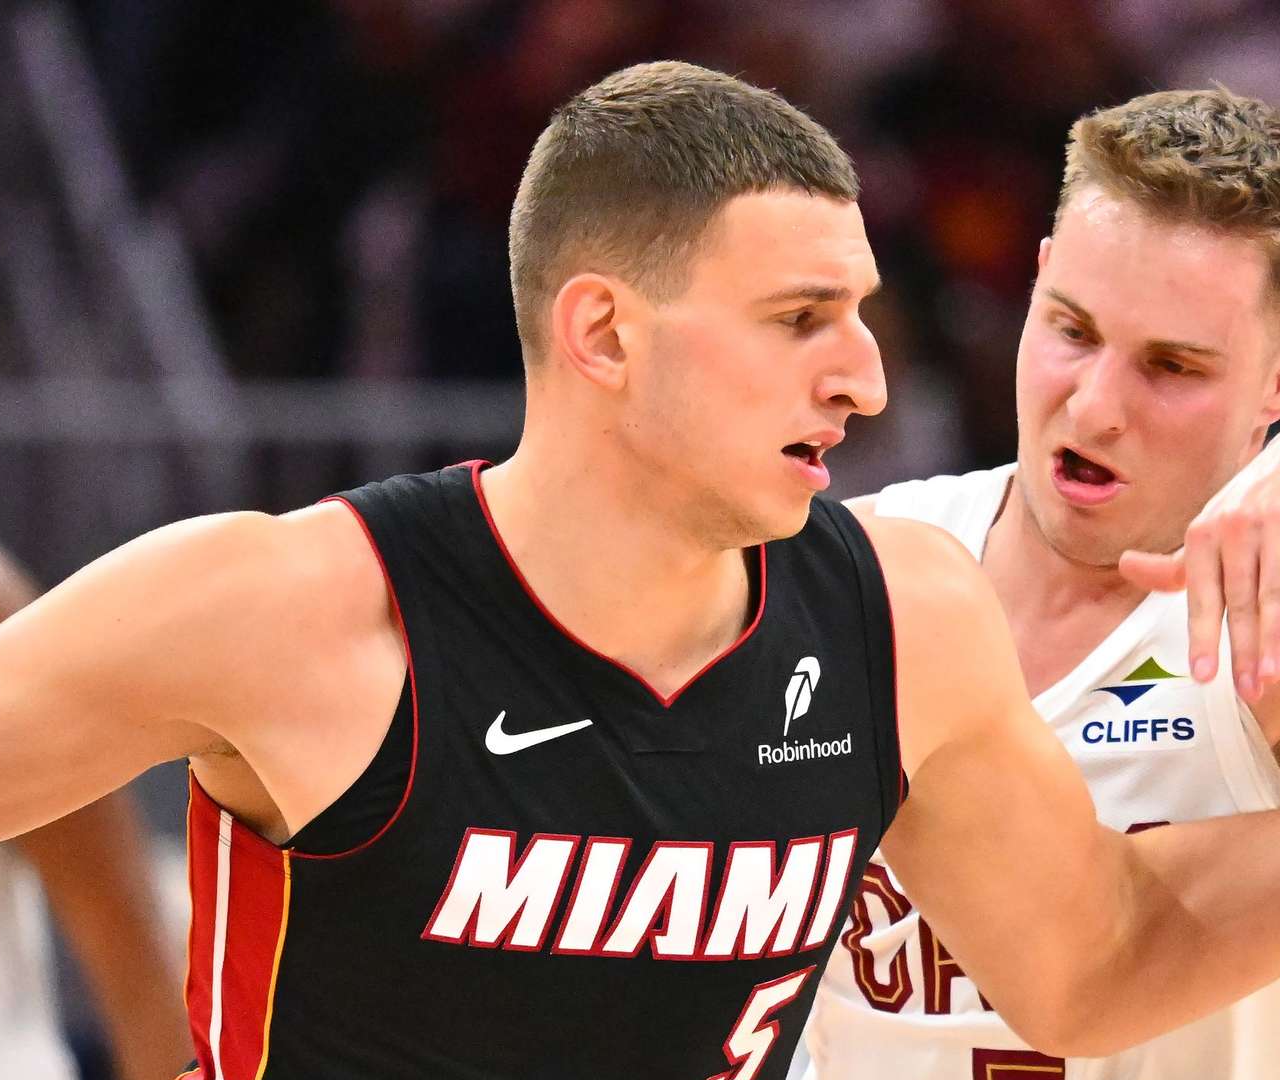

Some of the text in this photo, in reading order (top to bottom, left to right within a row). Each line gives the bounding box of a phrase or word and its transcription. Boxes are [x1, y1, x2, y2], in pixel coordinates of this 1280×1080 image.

[1082, 716, 1195, 743] CLIFFS
[757, 733, 852, 765] Robinhood
[421, 827, 859, 961] MIAMI
